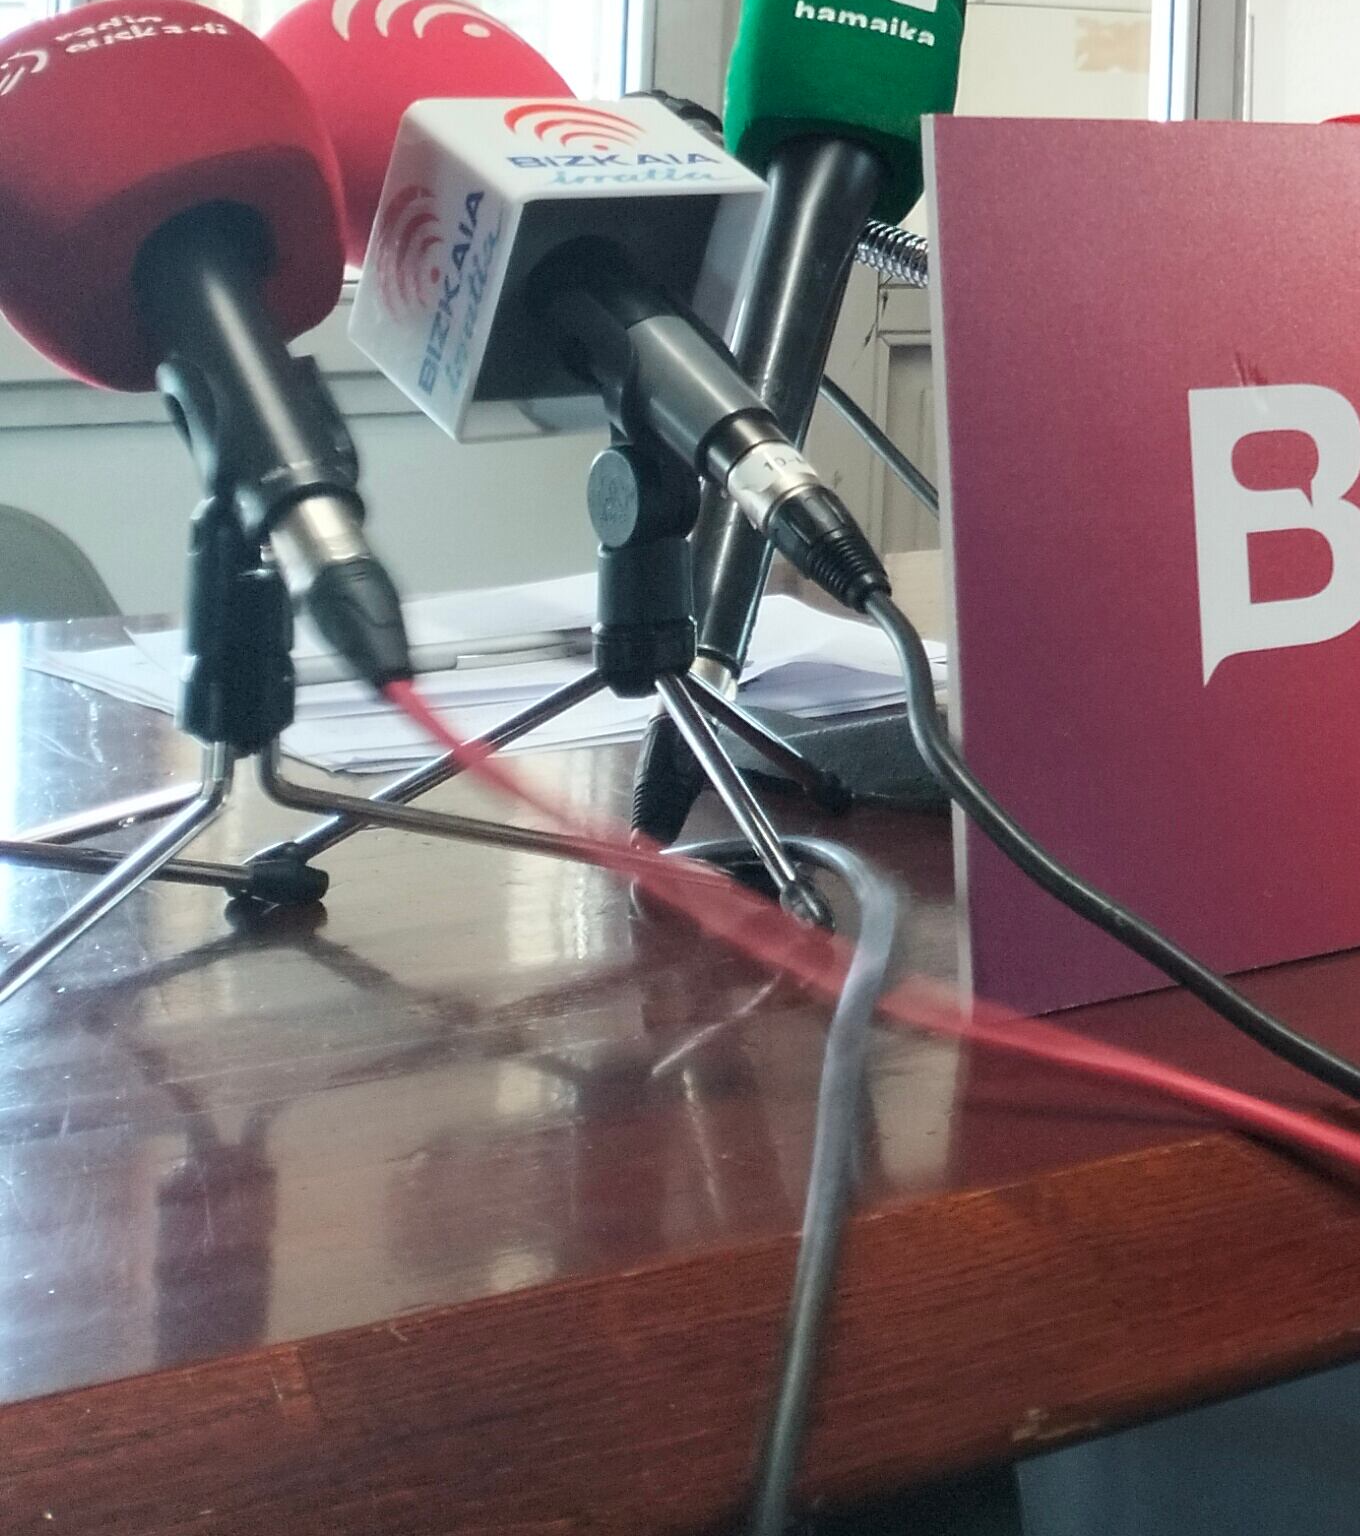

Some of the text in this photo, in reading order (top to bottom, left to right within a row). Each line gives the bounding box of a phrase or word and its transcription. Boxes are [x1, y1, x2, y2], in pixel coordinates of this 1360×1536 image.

[794, 0, 936, 47] hamaika
[506, 152, 721, 168] BIZKAIA
[417, 191, 485, 395] BIZKAIA
